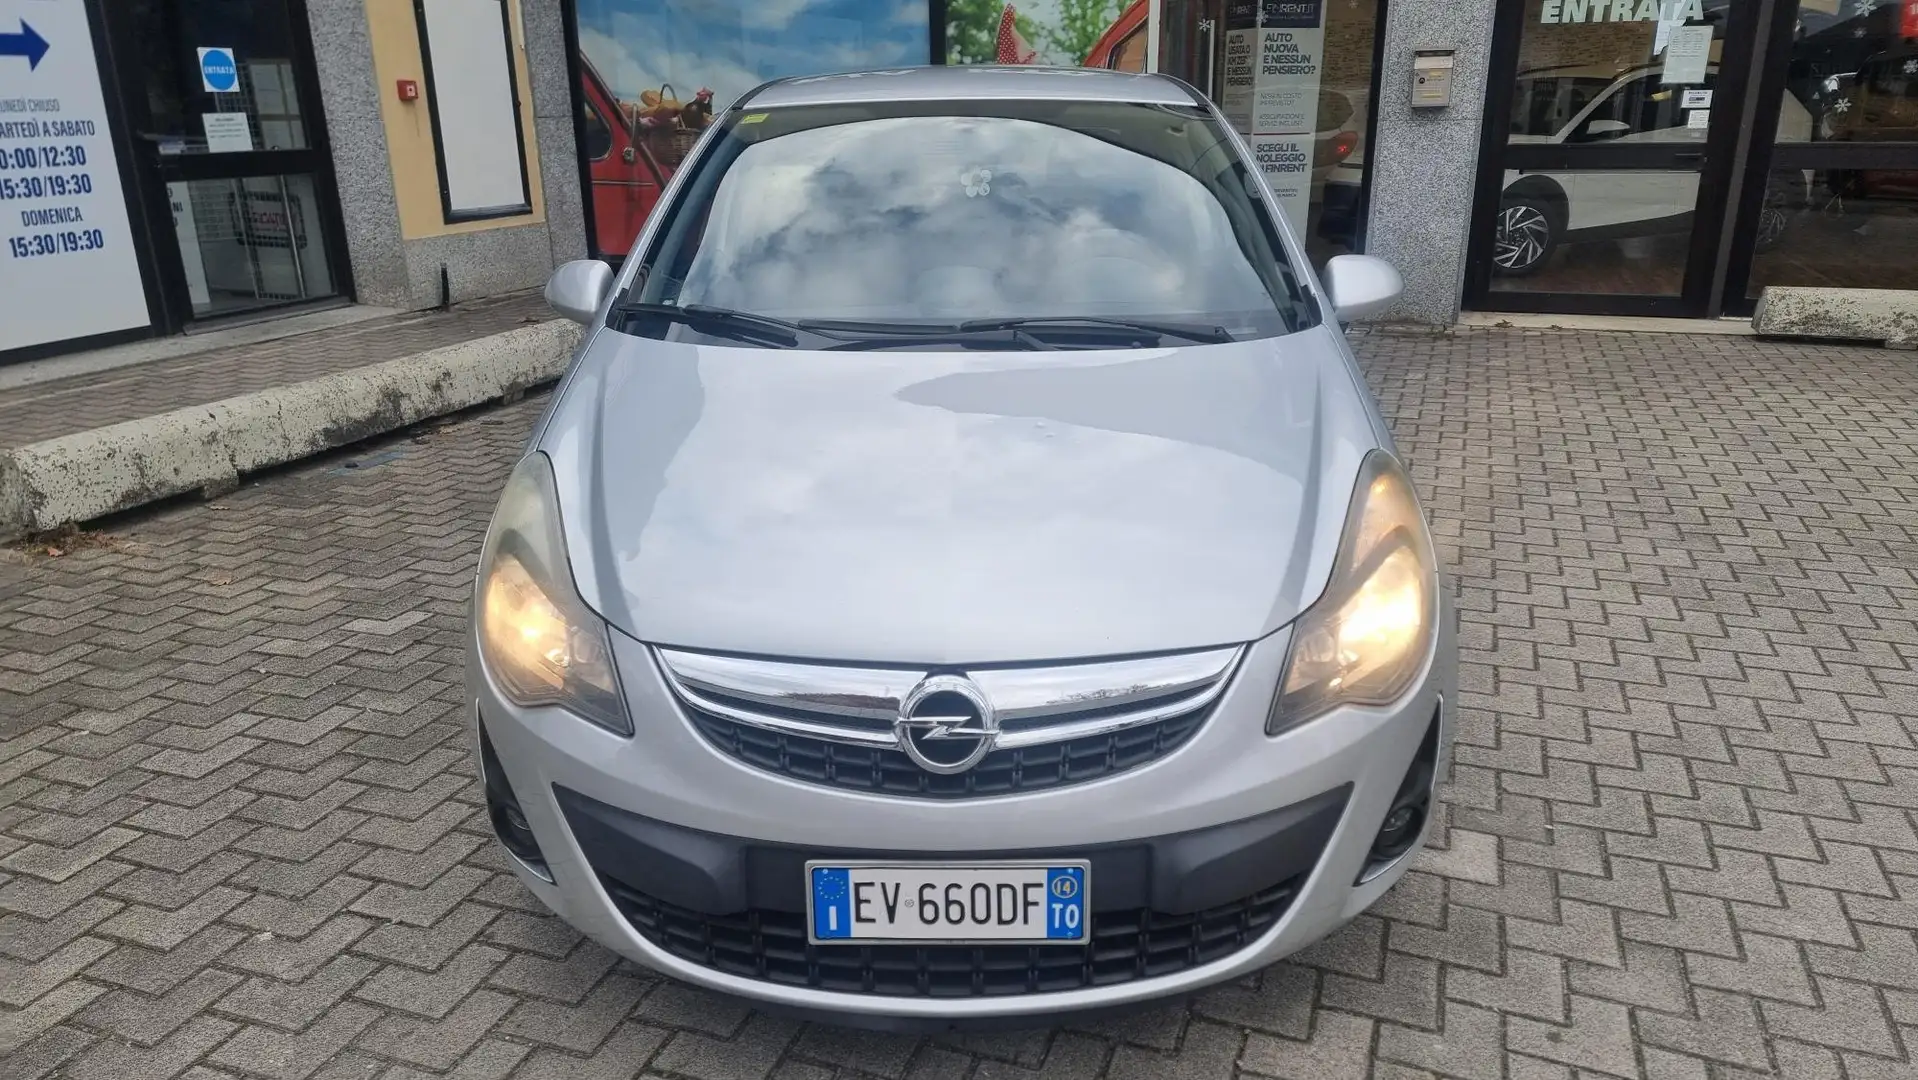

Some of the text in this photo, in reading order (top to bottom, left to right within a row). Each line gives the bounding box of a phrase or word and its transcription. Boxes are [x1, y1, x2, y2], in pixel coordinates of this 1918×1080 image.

[1541, 0, 1704, 24] ENTRATA
[1229, 34, 1244, 44] AUTO
[1264, 33, 1293, 42] AUTO
[1263, 43, 1299, 53] NUOVA
[1263, 54, 1312, 64] E NESSUN
[1262, 65, 1316, 75] PENSIERO?
[42, 120, 51, 137] A
[51, 119, 95, 137] SABATO
[1256, 143, 1300, 153] SCEGLI IL
[1256, 153, 1306, 163] NOLEGGIO
[1266, 163, 1307, 173] FINRENT
[0, 173, 92, 200] 15:30/19:30
[21, 206, 83, 227] DOMENICA
[9, 229, 104, 258] 15:30/19:30
[1056, 881, 1070, 894] 14
[853, 881, 1044, 925] EV 660DF
[829, 905, 837, 931] I
[1051, 903, 1079, 929] TO
